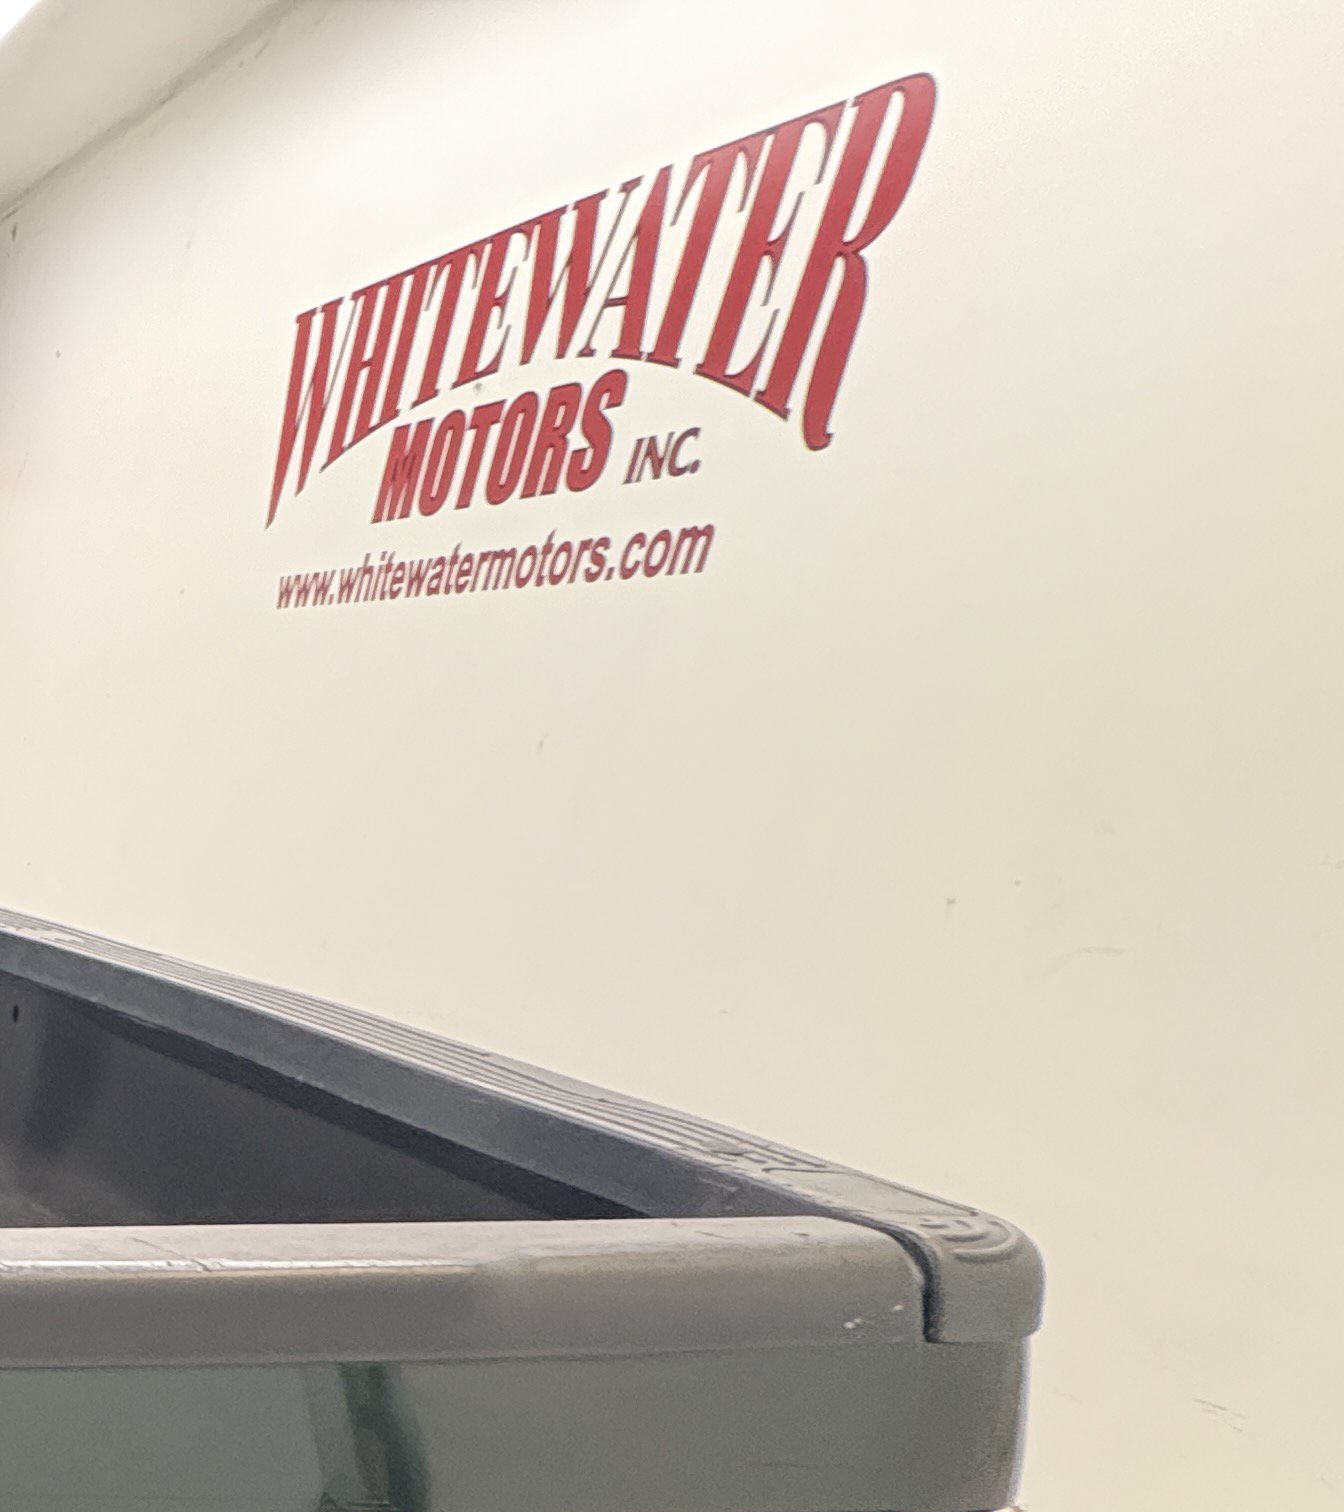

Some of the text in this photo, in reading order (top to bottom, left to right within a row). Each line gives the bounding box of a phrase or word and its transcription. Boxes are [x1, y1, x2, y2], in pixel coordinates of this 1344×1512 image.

[266, 72, 938, 530] WHITEWATER
[371, 370, 702, 524] MOTORS INC.
[276, 523, 715, 610] www.whitewatermotors.com
